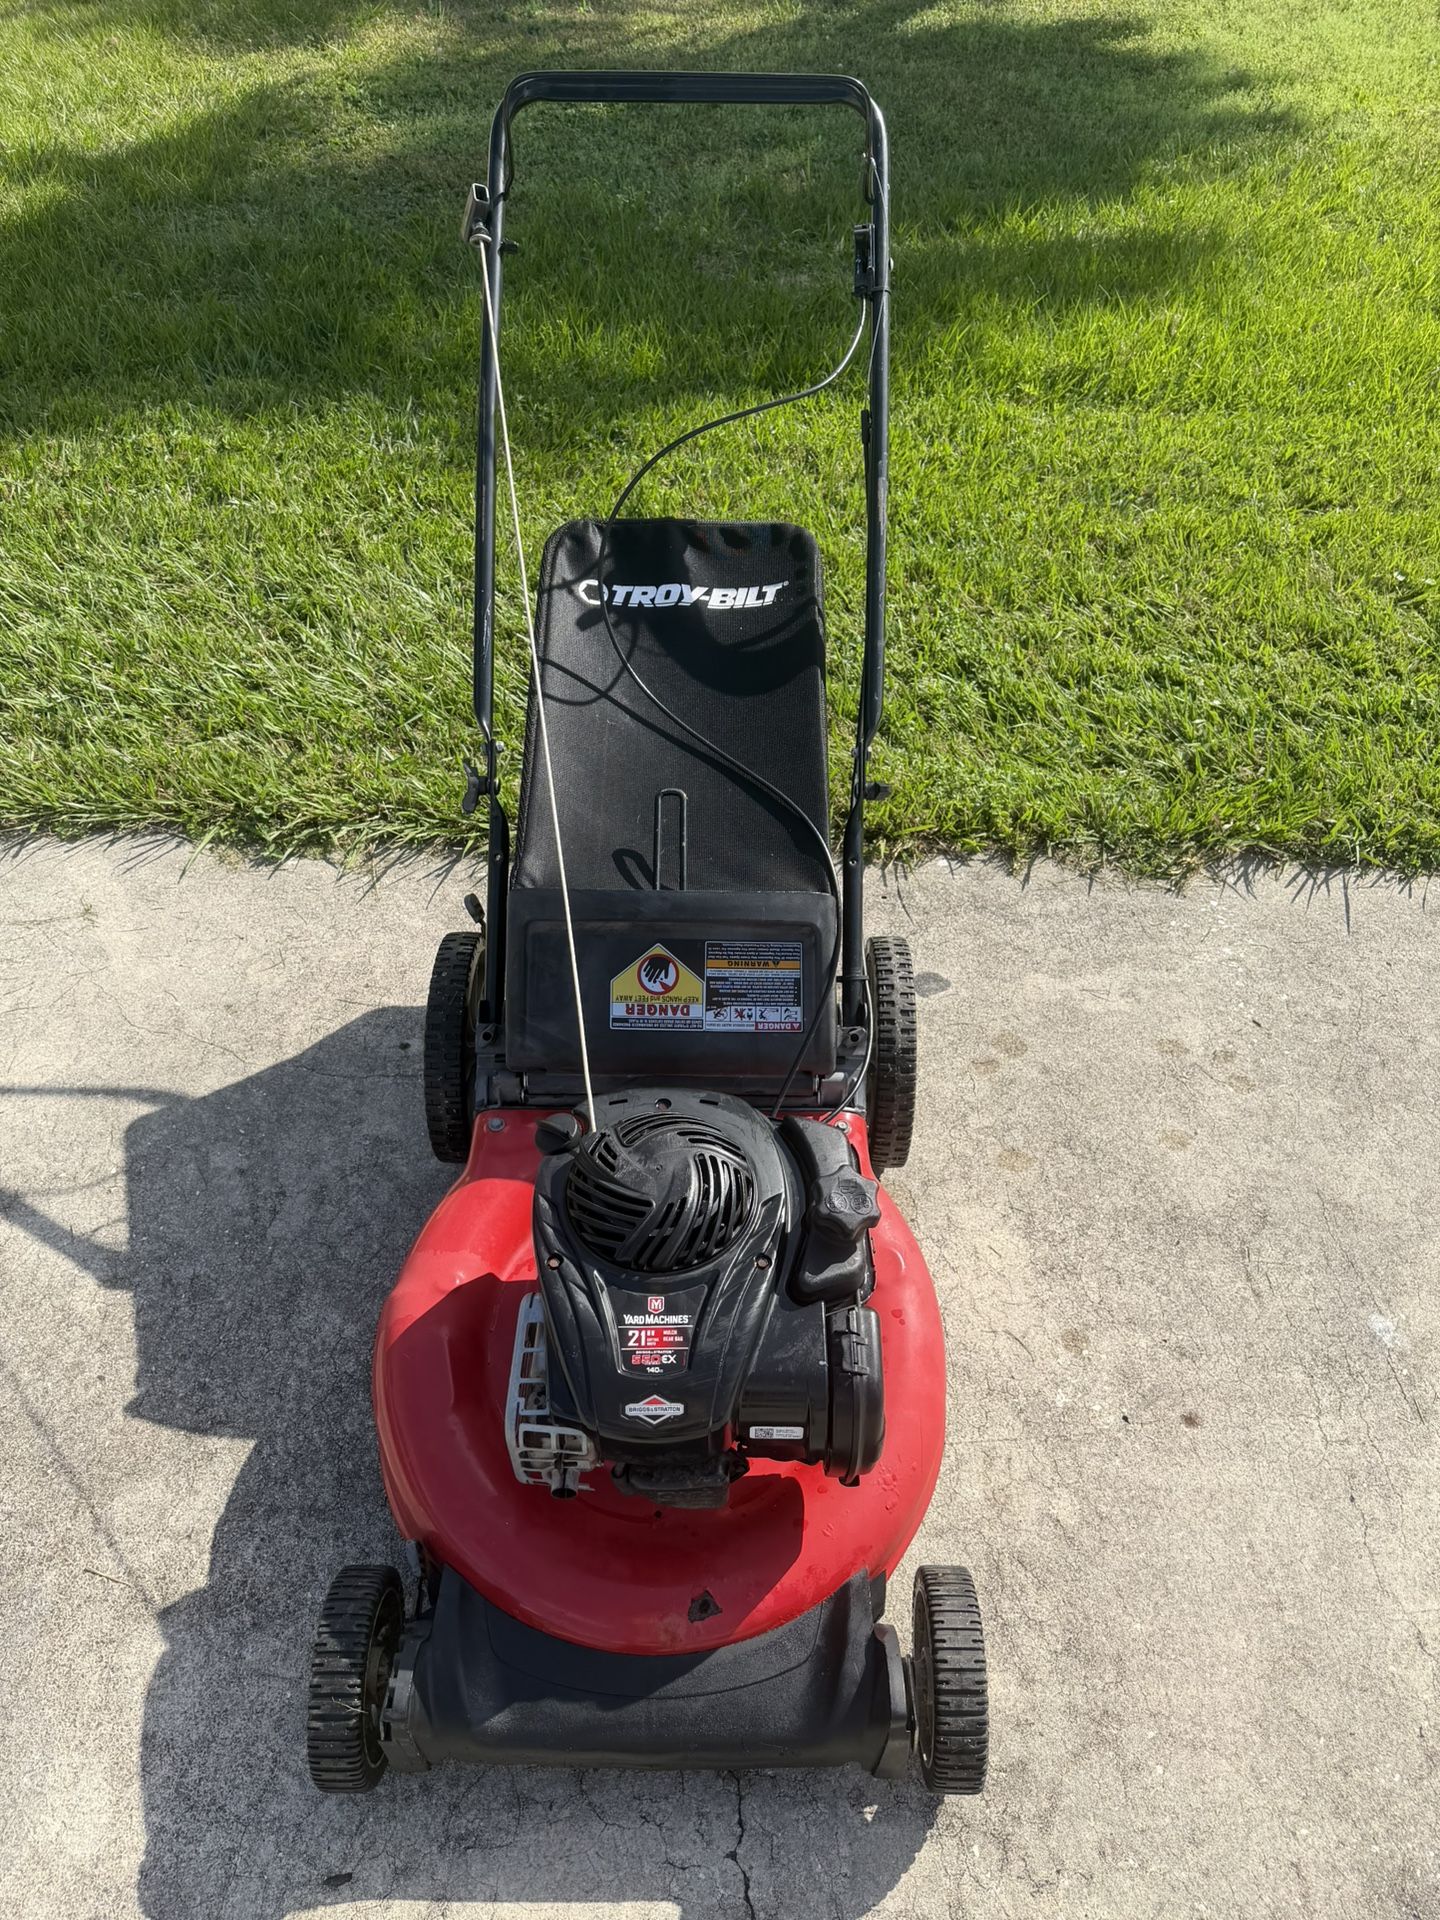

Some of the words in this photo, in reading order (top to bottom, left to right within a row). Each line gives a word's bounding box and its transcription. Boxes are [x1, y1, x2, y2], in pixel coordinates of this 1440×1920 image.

[611, 581, 785, 609] TROY-BILT
[727, 960, 770, 968] WARNING
[625, 1003, 690, 1017] DANGER
[757, 1022, 791, 1030] DANGER
[623, 1314, 645, 1325] YARD
[645, 1314, 689, 1325] MACHINES
